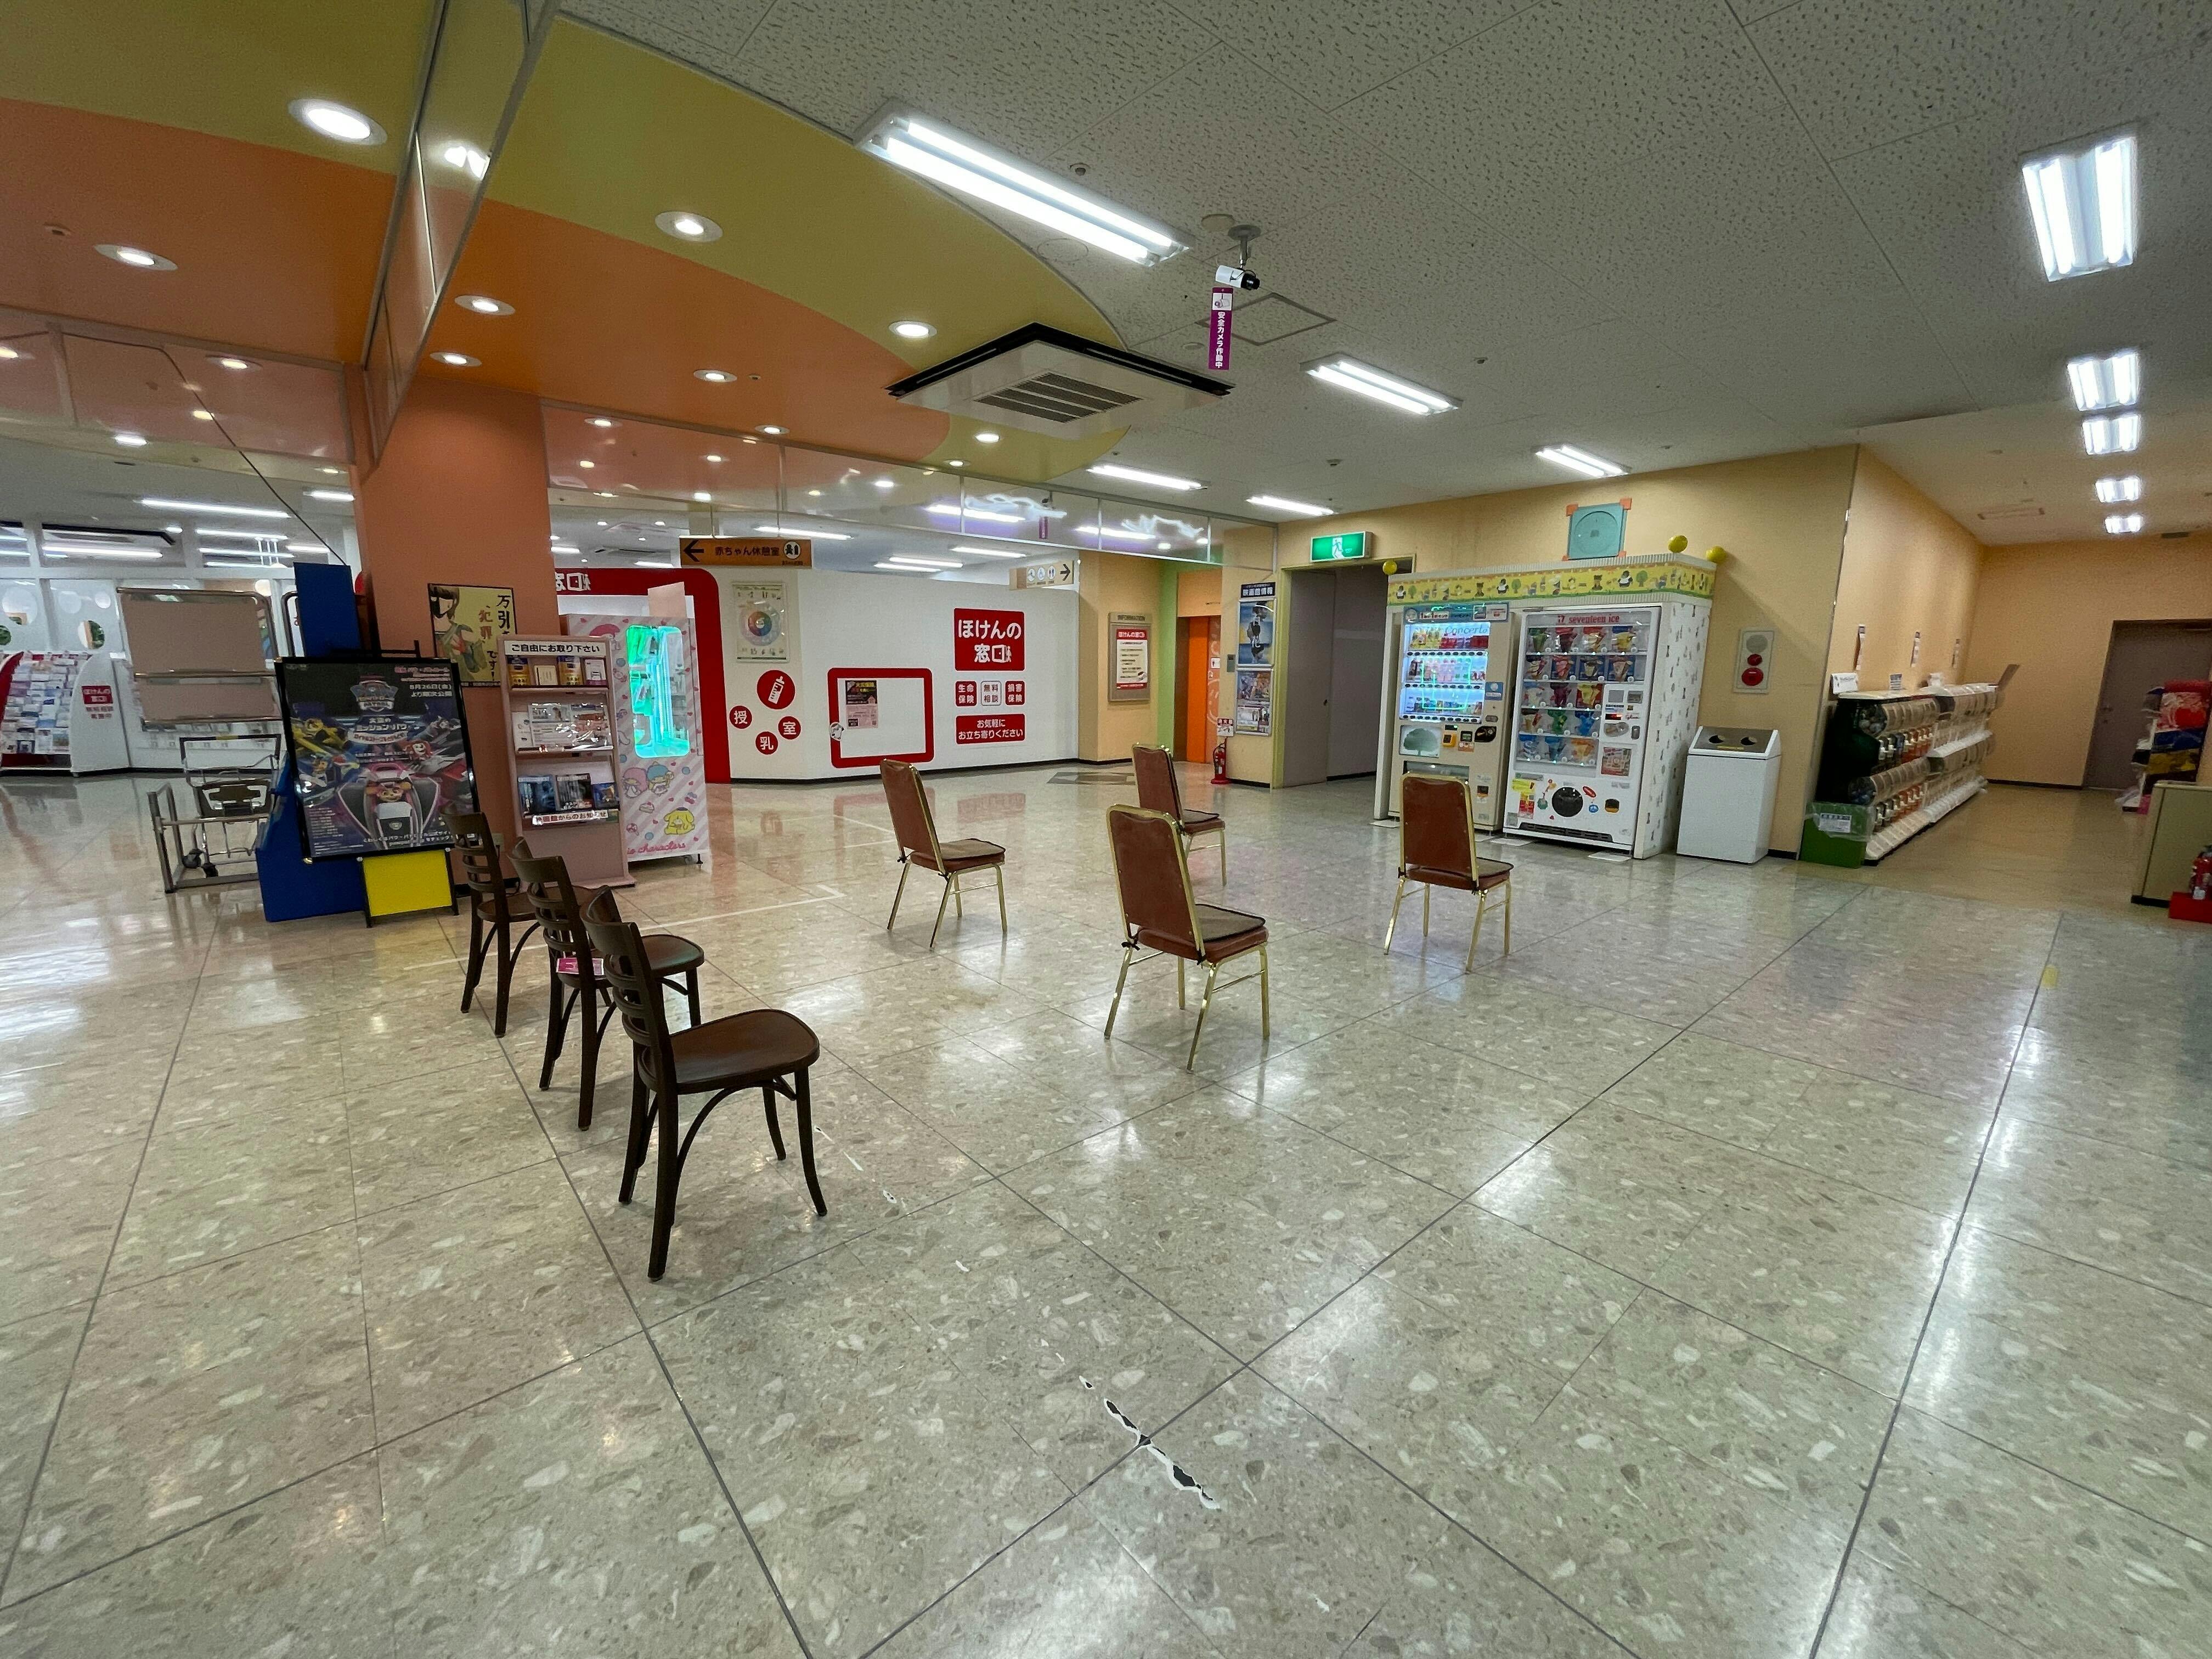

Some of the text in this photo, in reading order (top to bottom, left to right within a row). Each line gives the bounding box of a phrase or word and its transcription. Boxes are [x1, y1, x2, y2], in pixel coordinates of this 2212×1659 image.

[715, 546, 779, 556] 赤ちゃん休憩室
[496, 595, 511, 634] 万引
[1569, 616, 1606, 624] seventeen
[1609, 614, 1620, 623] ice
[958, 619, 1022, 639] ほけんの
[1444, 626, 1488, 635] Concerto
[512, 644, 600, 652] ご自由にお取り下さい
[974, 644, 1007, 663] 窓口
[958, 684, 974, 692] 生命
[958, 695, 974, 704] 保険
[1008, 694, 1023, 703] 保険
[977, 719, 1006, 727] お気軽に
[958, 729, 1023, 741] お立ち寄りください
